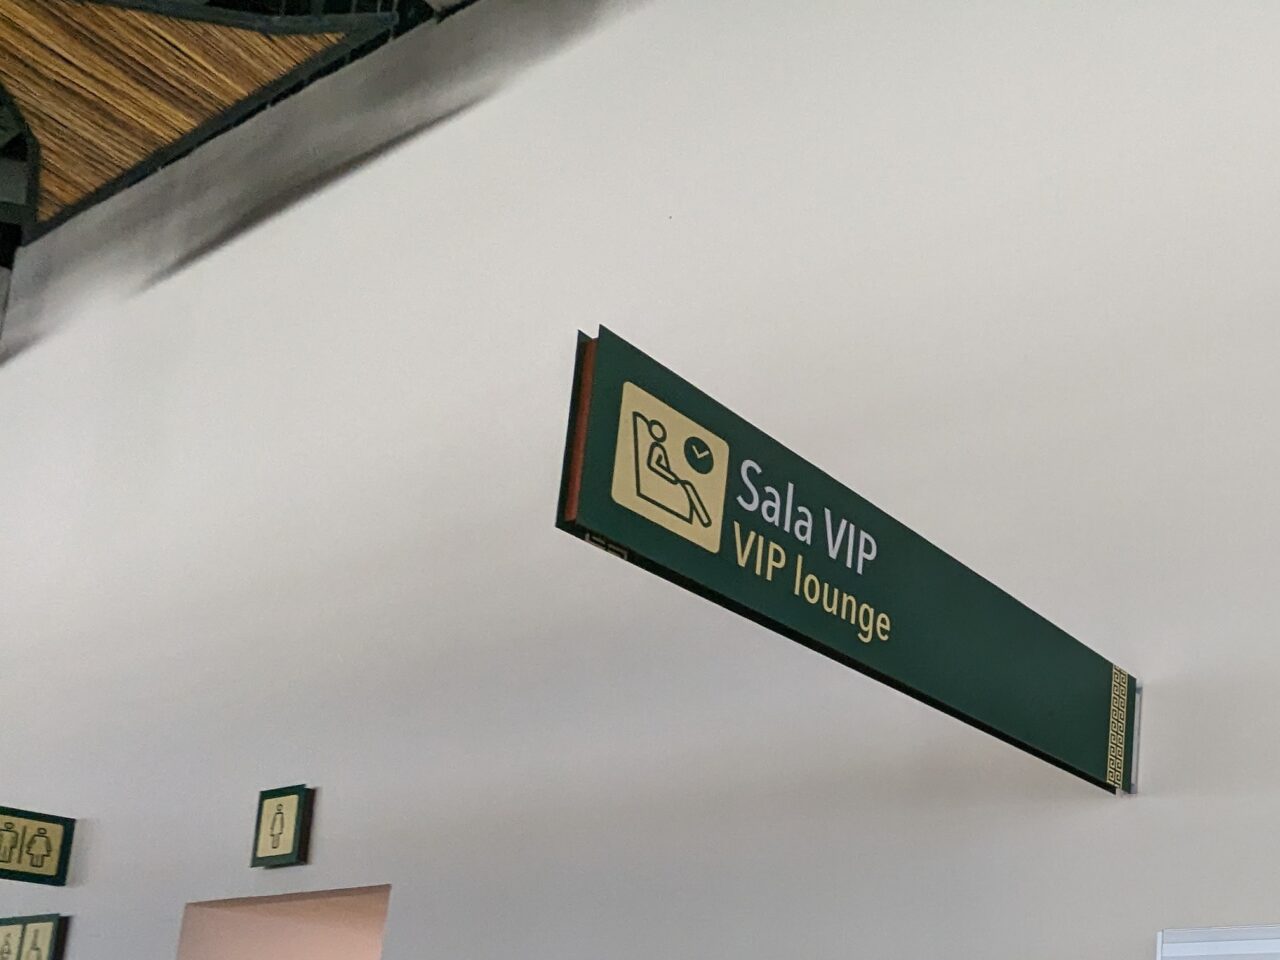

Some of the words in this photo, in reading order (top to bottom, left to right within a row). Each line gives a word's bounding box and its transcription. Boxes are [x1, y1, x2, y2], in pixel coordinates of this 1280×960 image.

[736, 459, 813, 546] Sala
[824, 507, 877, 575] VIP
[733, 520, 786, 581] VIP
[794, 554, 891, 643] lounge
